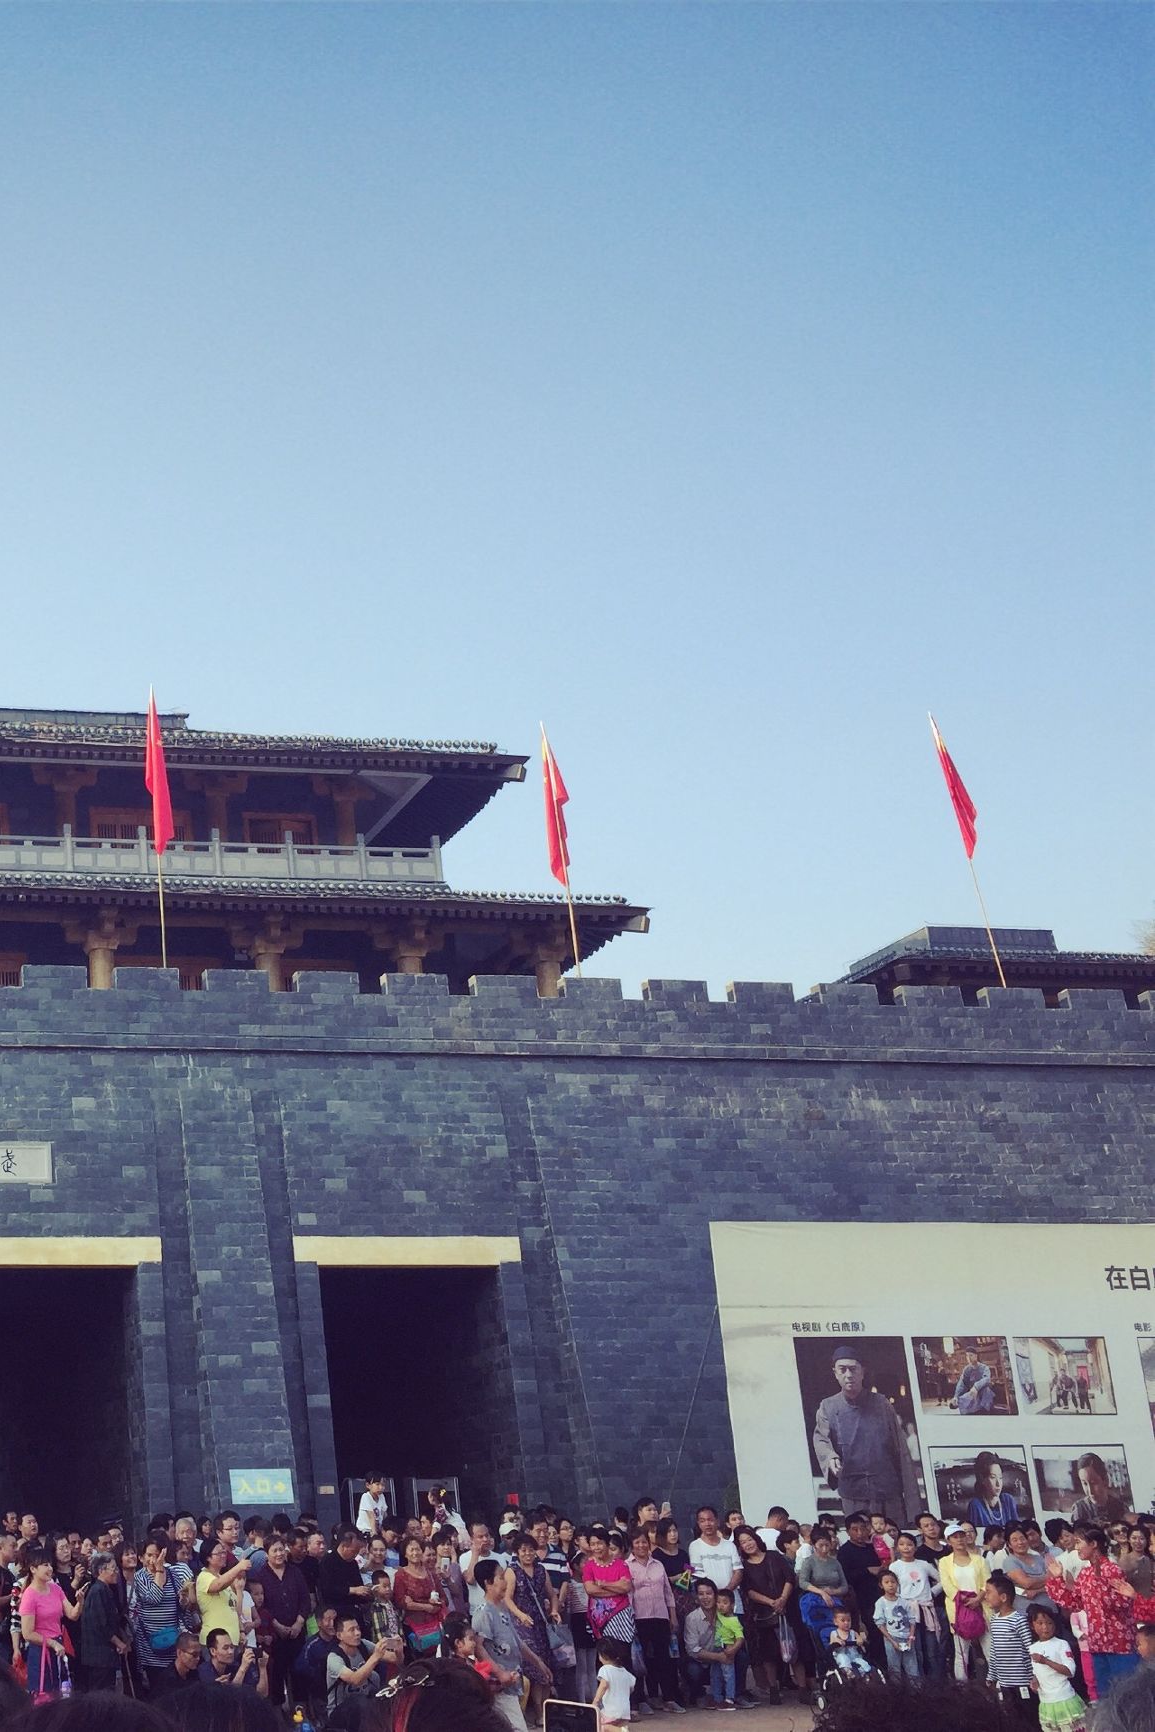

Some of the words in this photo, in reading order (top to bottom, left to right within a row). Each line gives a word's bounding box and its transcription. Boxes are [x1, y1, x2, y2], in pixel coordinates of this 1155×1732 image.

[1104, 1265, 1155, 1290] 在白
[1134, 1322, 1152, 1332] 电影
[237, 1477, 270, 1495] 入口
